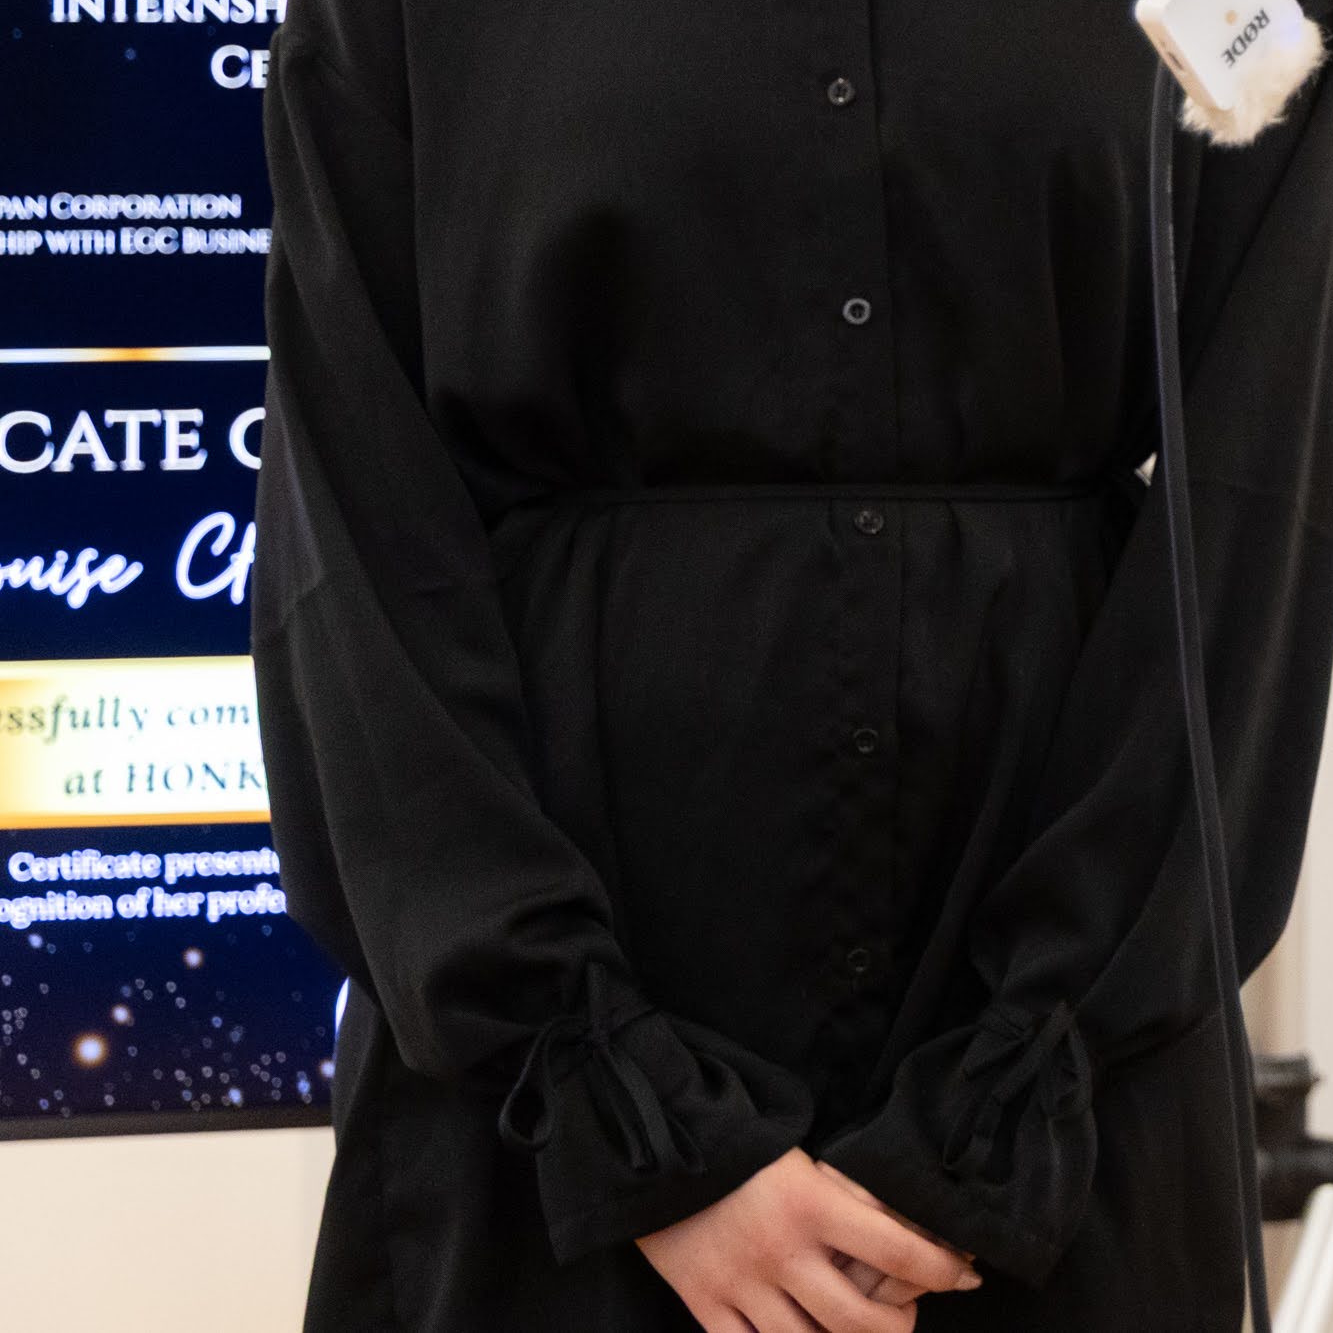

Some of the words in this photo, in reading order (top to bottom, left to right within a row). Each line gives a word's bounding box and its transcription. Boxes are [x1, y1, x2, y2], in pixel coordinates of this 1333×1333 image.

[50, 191, 242, 220] CORPORATION
[63, 768, 104, 795] at
[8, 848, 162, 883] Certificate
[116, 885, 152, 919] of
[152, 885, 206, 919] her
